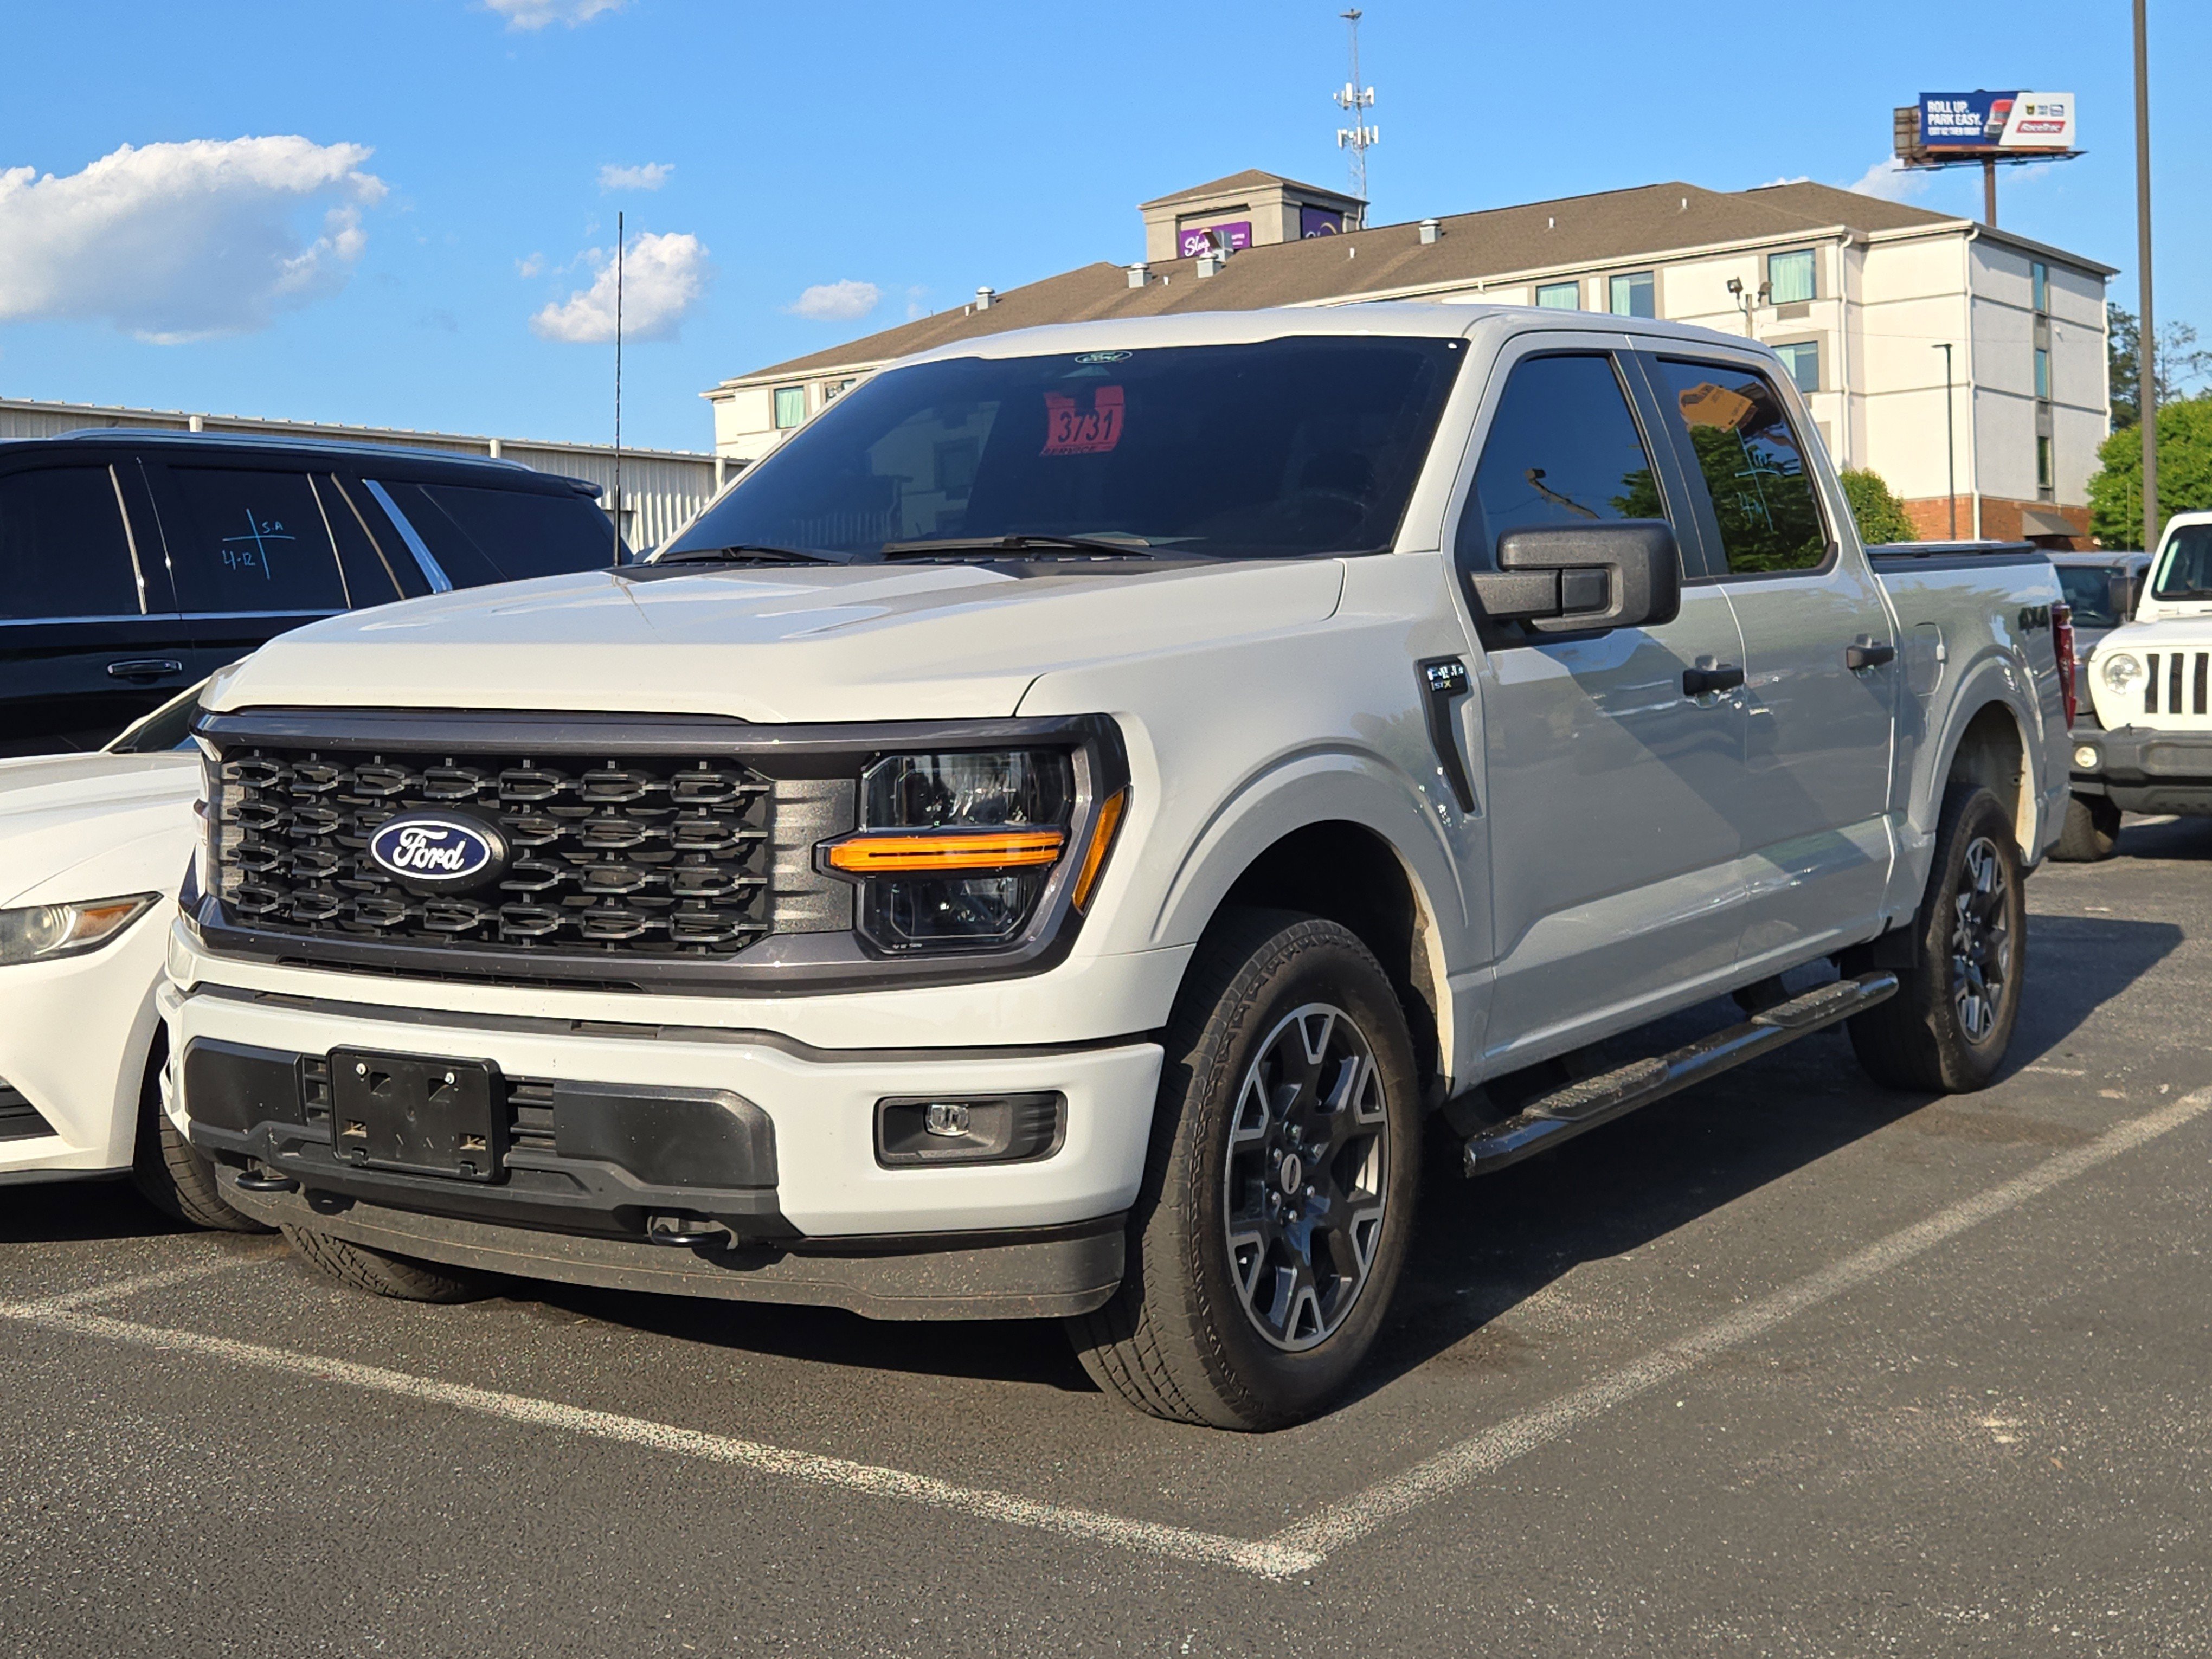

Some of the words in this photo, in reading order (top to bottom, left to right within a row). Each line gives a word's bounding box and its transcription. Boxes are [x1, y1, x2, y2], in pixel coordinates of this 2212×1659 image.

[1928, 113, 1954, 125] PARK
[1058, 410, 1114, 443] 3731
[393, 828, 466, 870] Ford
